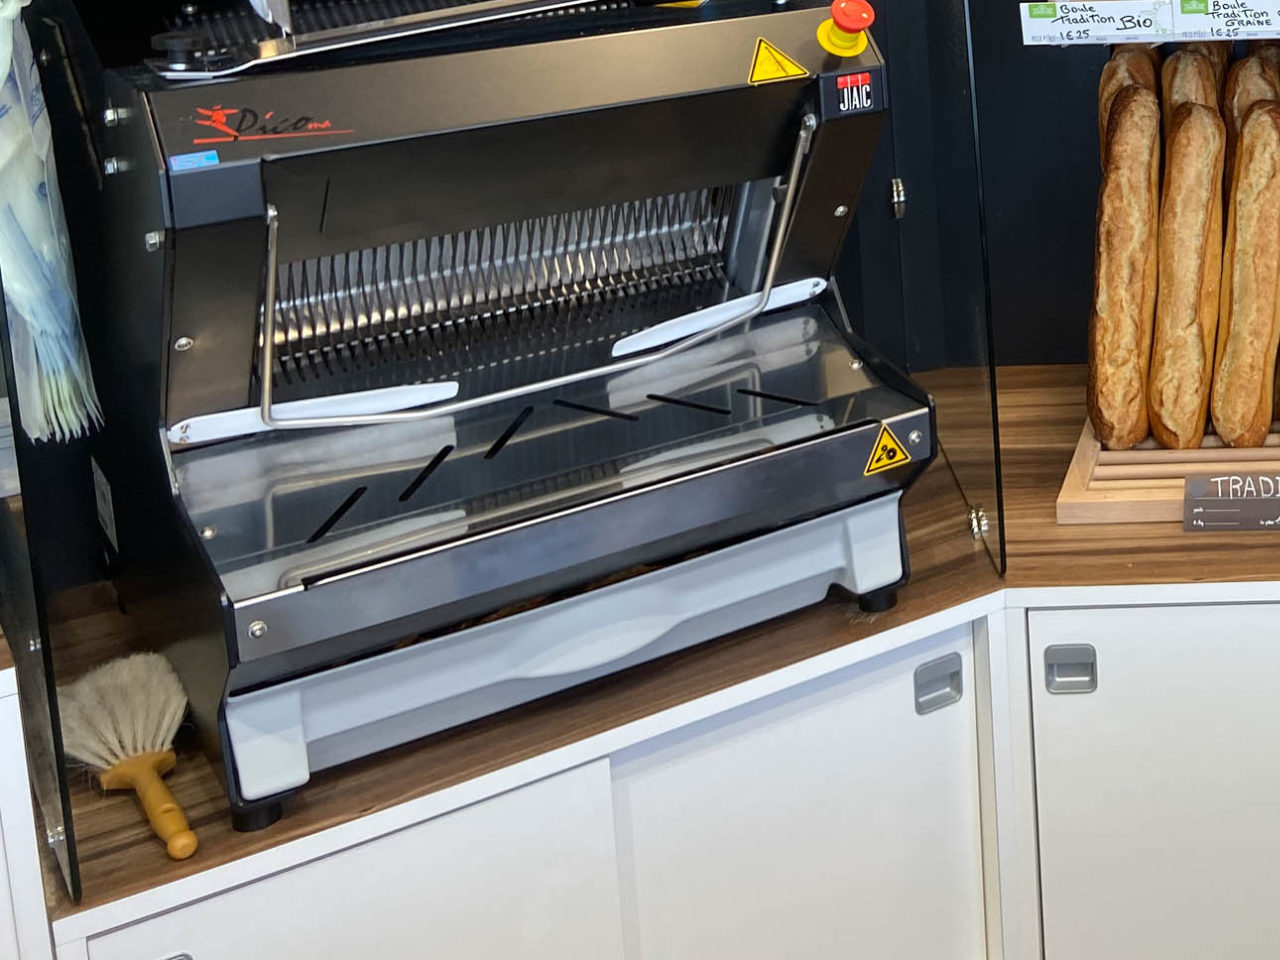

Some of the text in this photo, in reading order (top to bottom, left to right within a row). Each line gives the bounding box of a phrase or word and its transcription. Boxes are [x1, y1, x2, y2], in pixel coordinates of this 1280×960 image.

[1060, 4, 1096, 14] Boule
[1212, 0, 1248, 11] Boule
[1116, 15, 1153, 31] Bio
[840, 85, 871, 110] JAC
